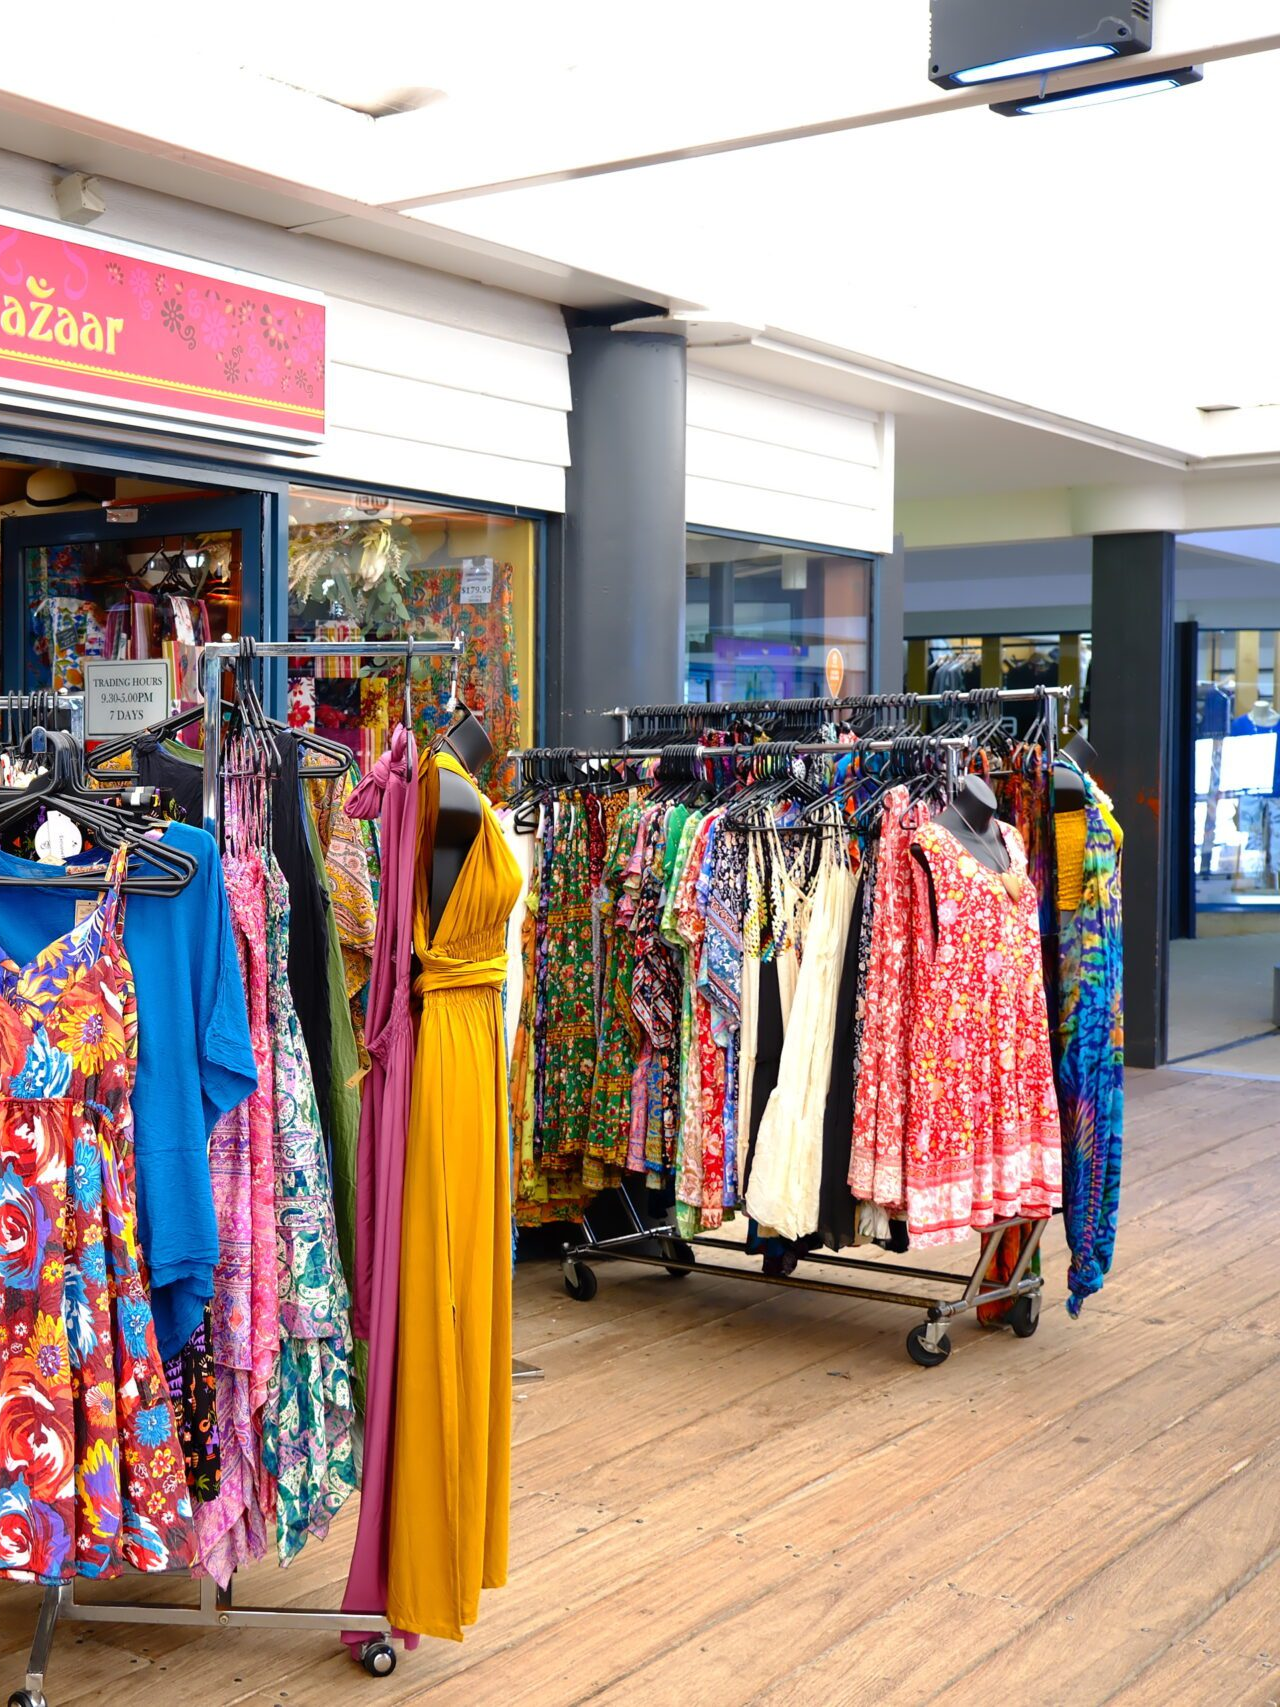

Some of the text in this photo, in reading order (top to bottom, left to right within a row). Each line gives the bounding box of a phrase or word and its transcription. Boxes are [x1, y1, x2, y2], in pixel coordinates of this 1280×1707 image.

[93, 676, 163, 688] TRADING HOURS
[100, 692, 153, 704] 9.30-5.00PM
[109, 709, 144, 721] 7 DAYS
